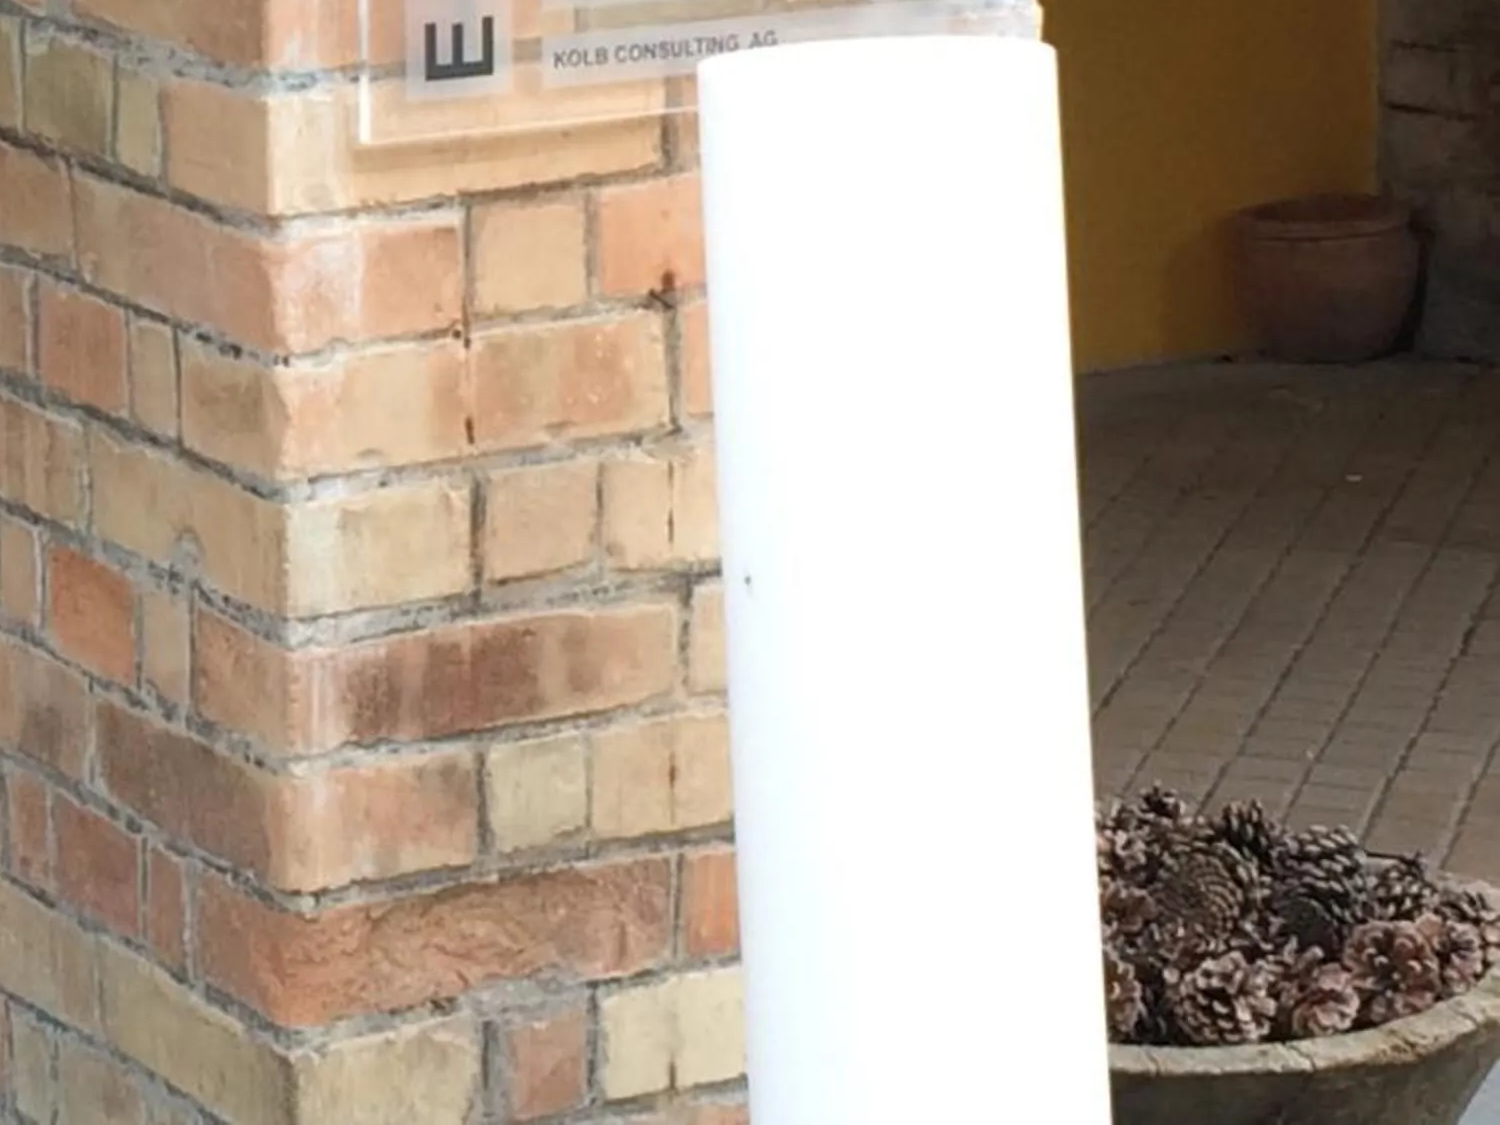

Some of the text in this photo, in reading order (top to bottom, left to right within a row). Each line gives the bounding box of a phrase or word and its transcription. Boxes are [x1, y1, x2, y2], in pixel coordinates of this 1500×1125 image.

[553, 30, 779, 69] KOLB CONSULTING AG
